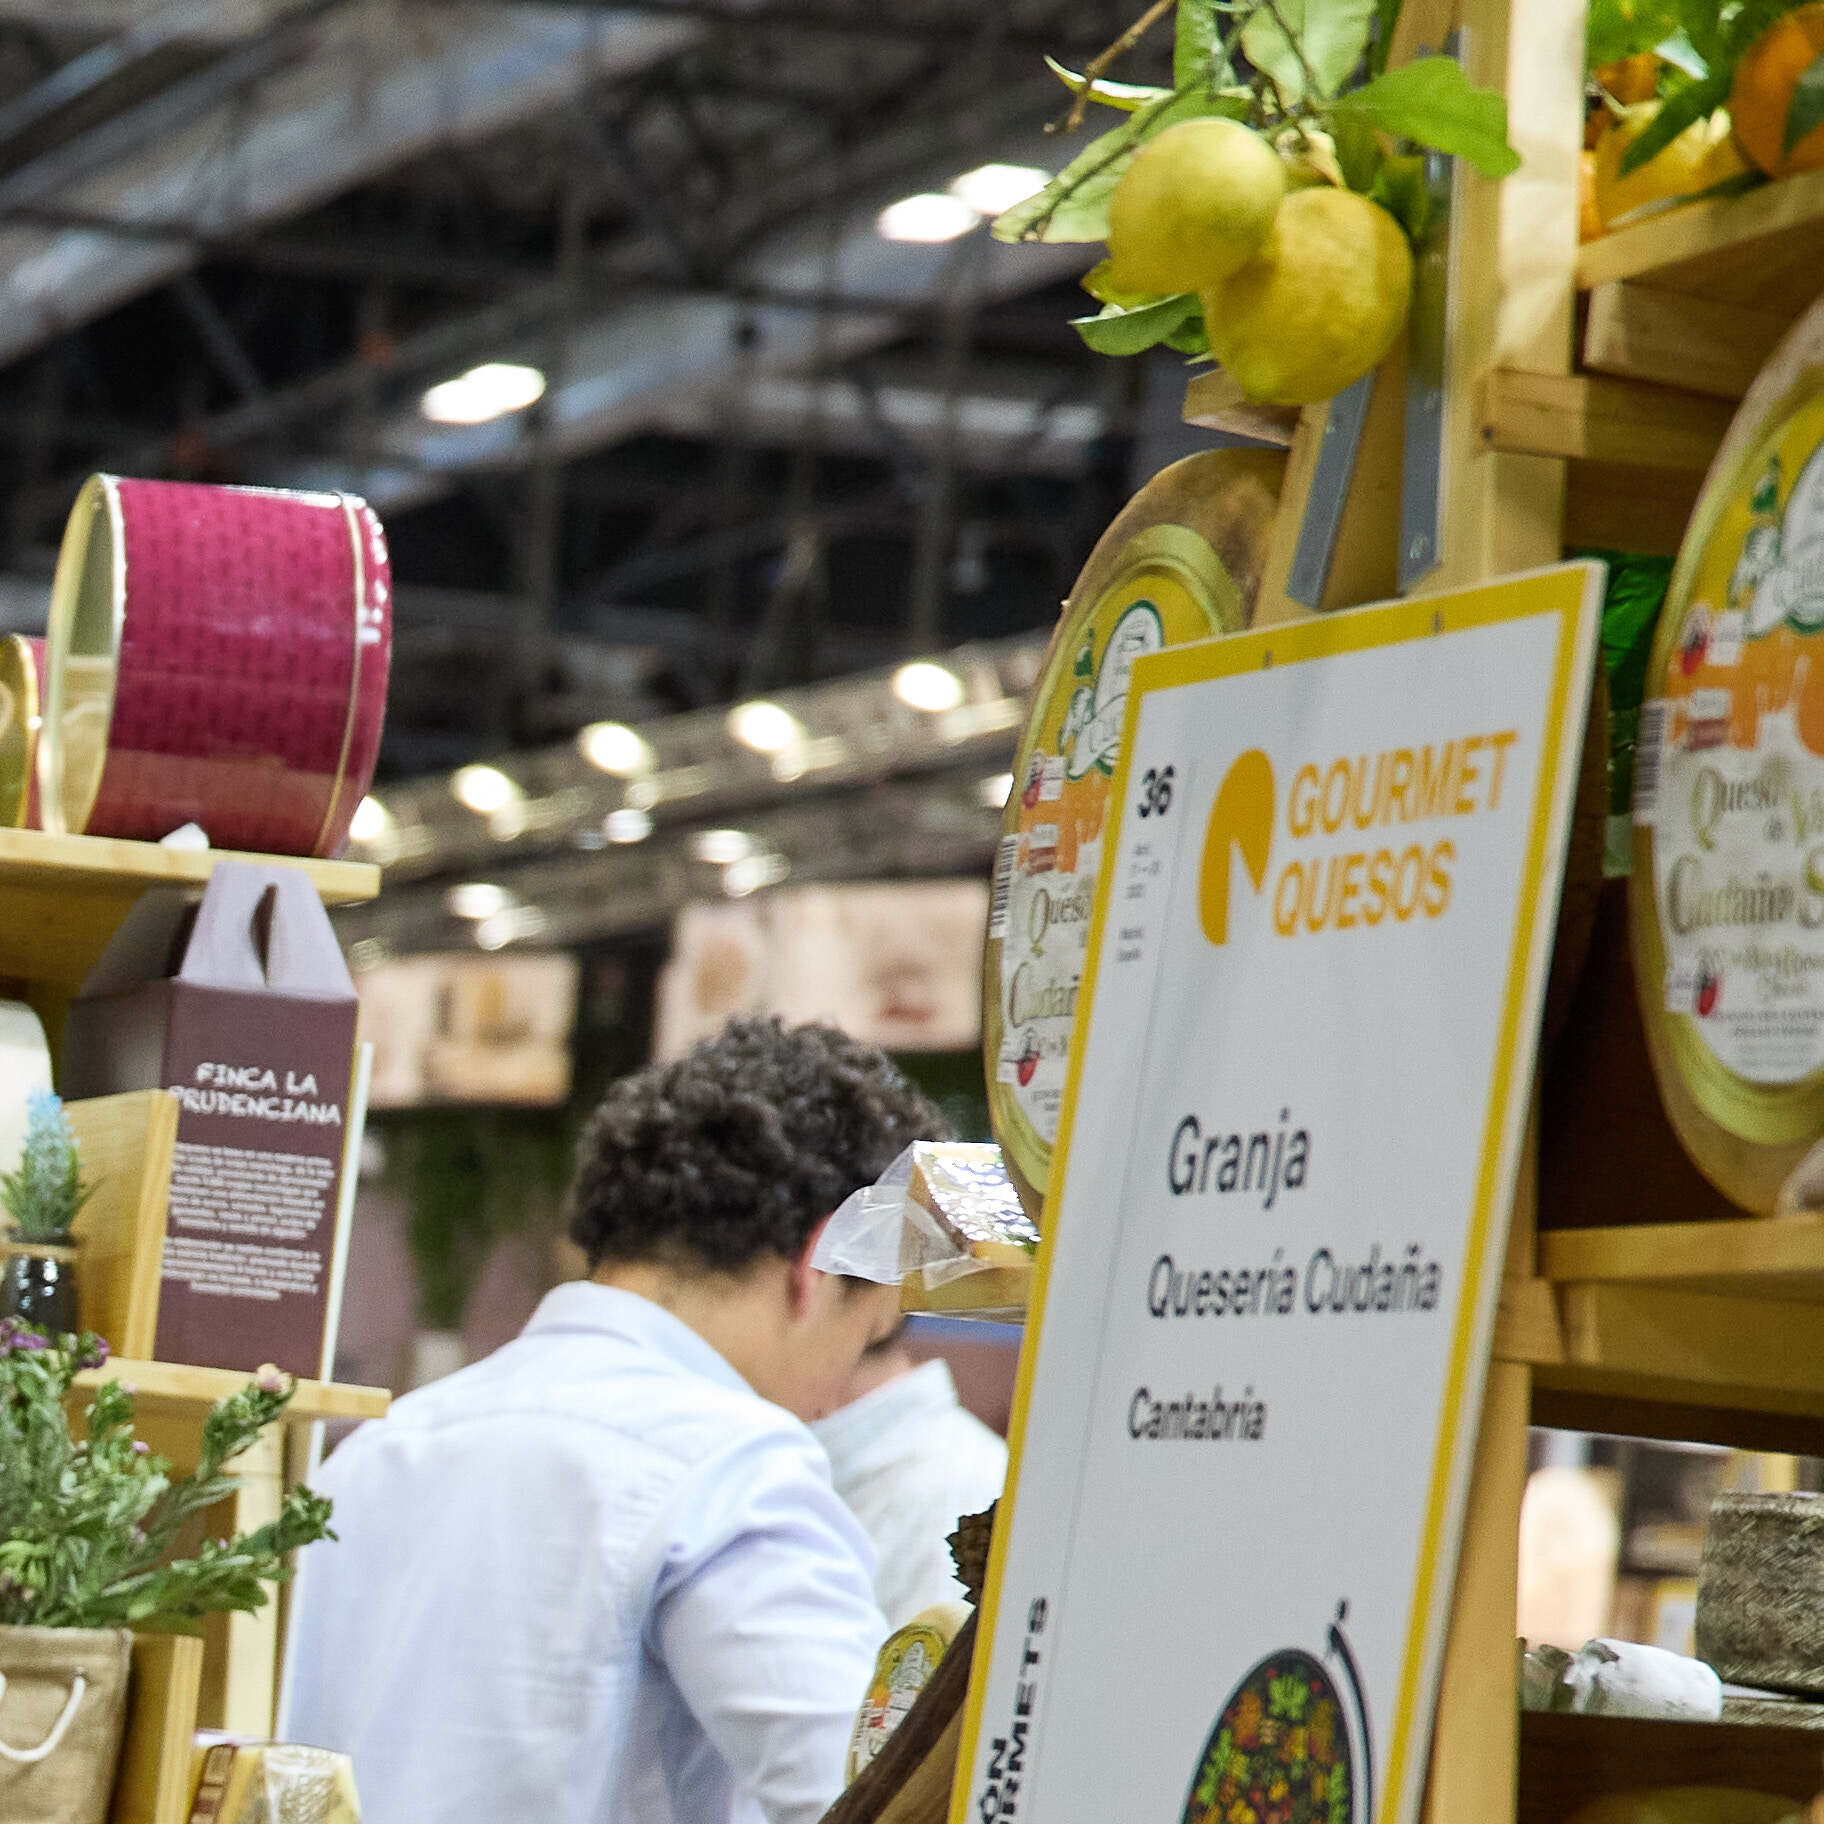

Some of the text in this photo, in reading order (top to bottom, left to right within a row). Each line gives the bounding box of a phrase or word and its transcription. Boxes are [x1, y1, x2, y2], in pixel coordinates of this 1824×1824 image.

[1137, 764, 1176, 819] 36
[1286, 730, 1520, 839] GOURMET
[1272, 840, 1457, 937] QUESOS
[196, 1062, 319, 1097] FINCA LA
[1168, 1107, 1312, 1210] Granja
[1147, 1242, 1442, 1319] Quesería Cudaña
[1128, 1385, 1268, 1441] Cantabria
